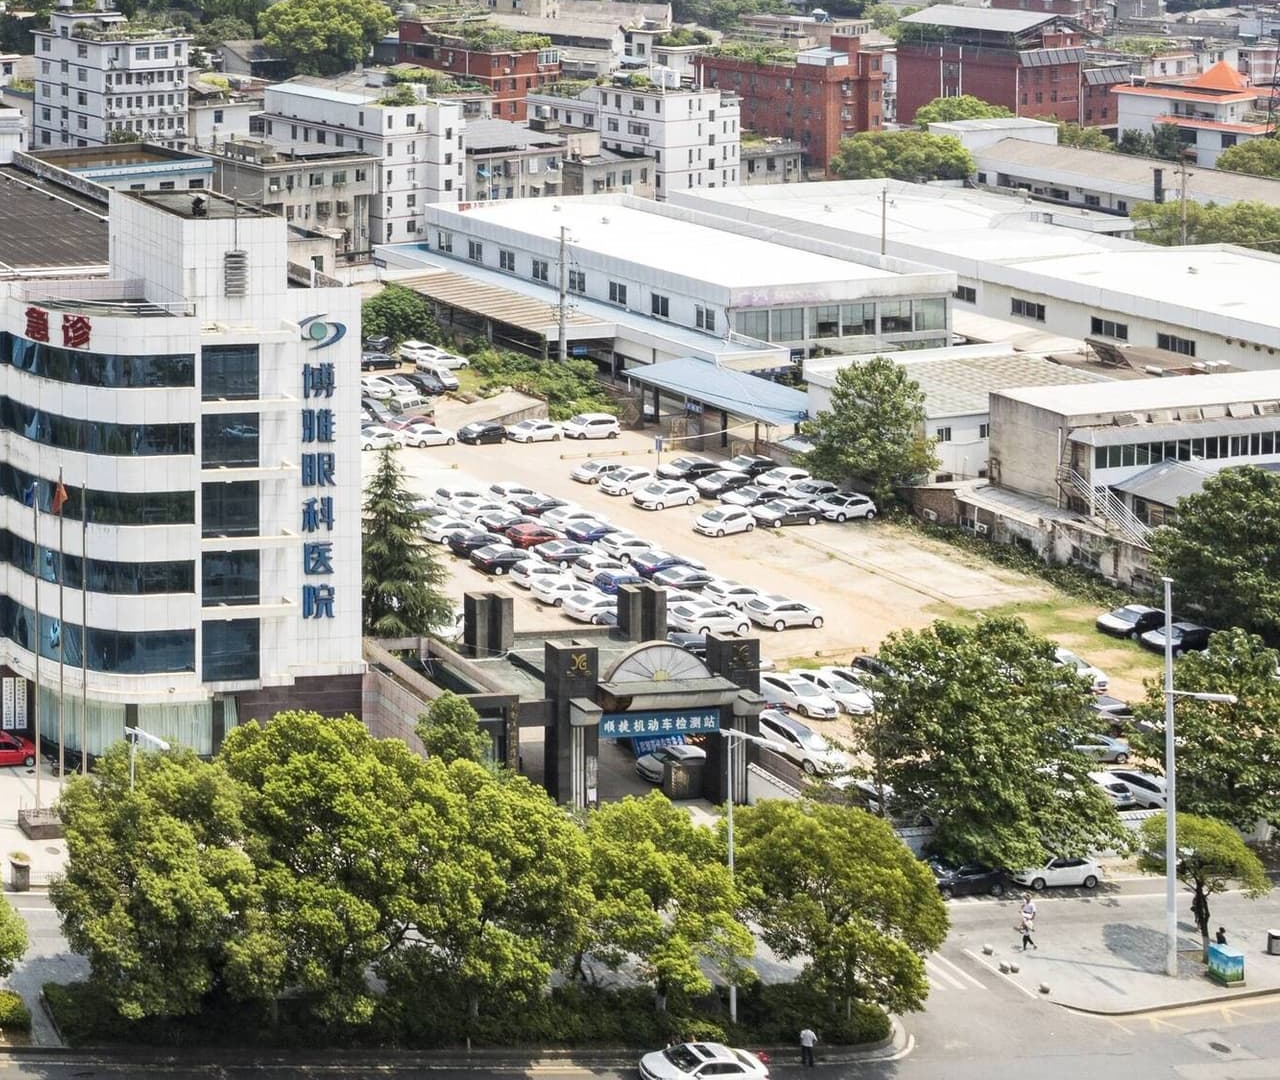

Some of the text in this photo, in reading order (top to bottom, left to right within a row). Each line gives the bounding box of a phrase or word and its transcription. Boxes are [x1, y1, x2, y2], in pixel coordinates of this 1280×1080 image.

[24, 306, 93, 349] 急诊
[300, 361, 337, 621] 博雅眼科医院
[603, 715, 716, 733] 顺捷机动车检测站
